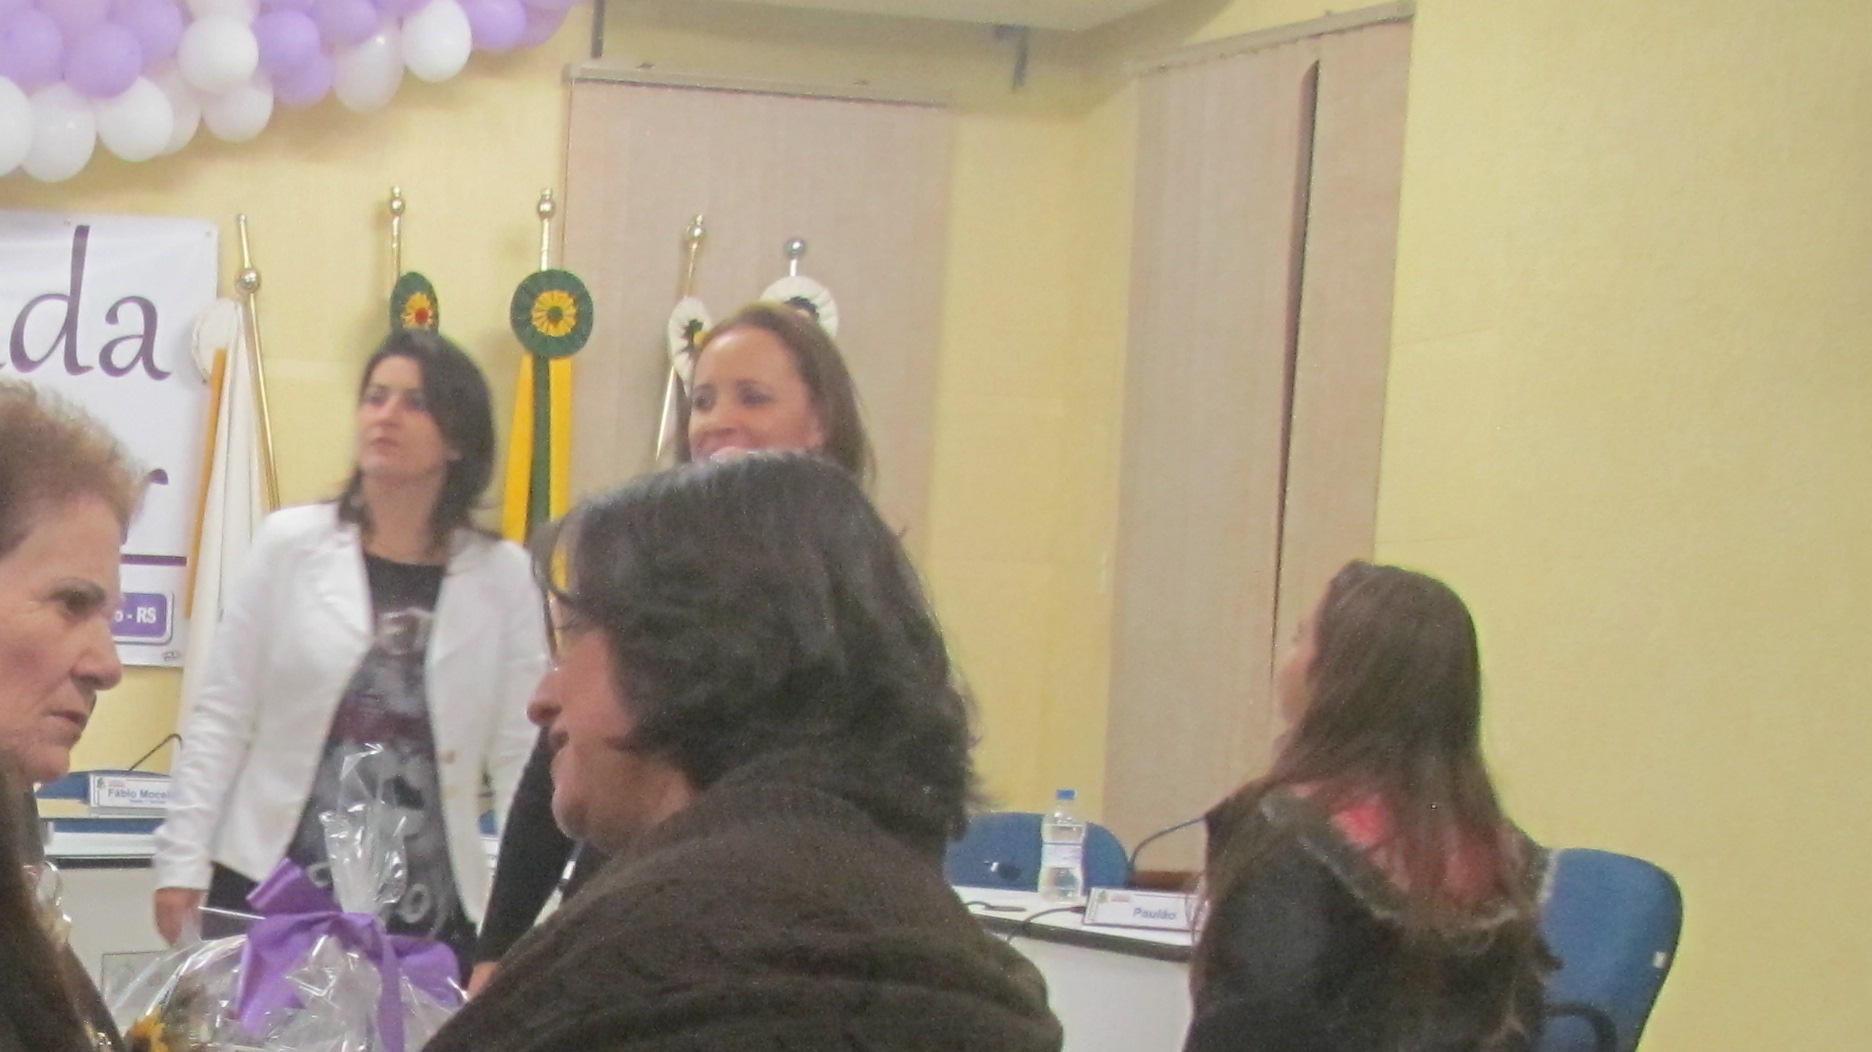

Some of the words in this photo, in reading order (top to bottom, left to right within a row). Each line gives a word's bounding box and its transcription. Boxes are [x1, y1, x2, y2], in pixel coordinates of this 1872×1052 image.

[136, 606, 157, 624] RS
[107, 787, 137, 799] Fábio
[1133, 907, 1177, 920] Paulão
